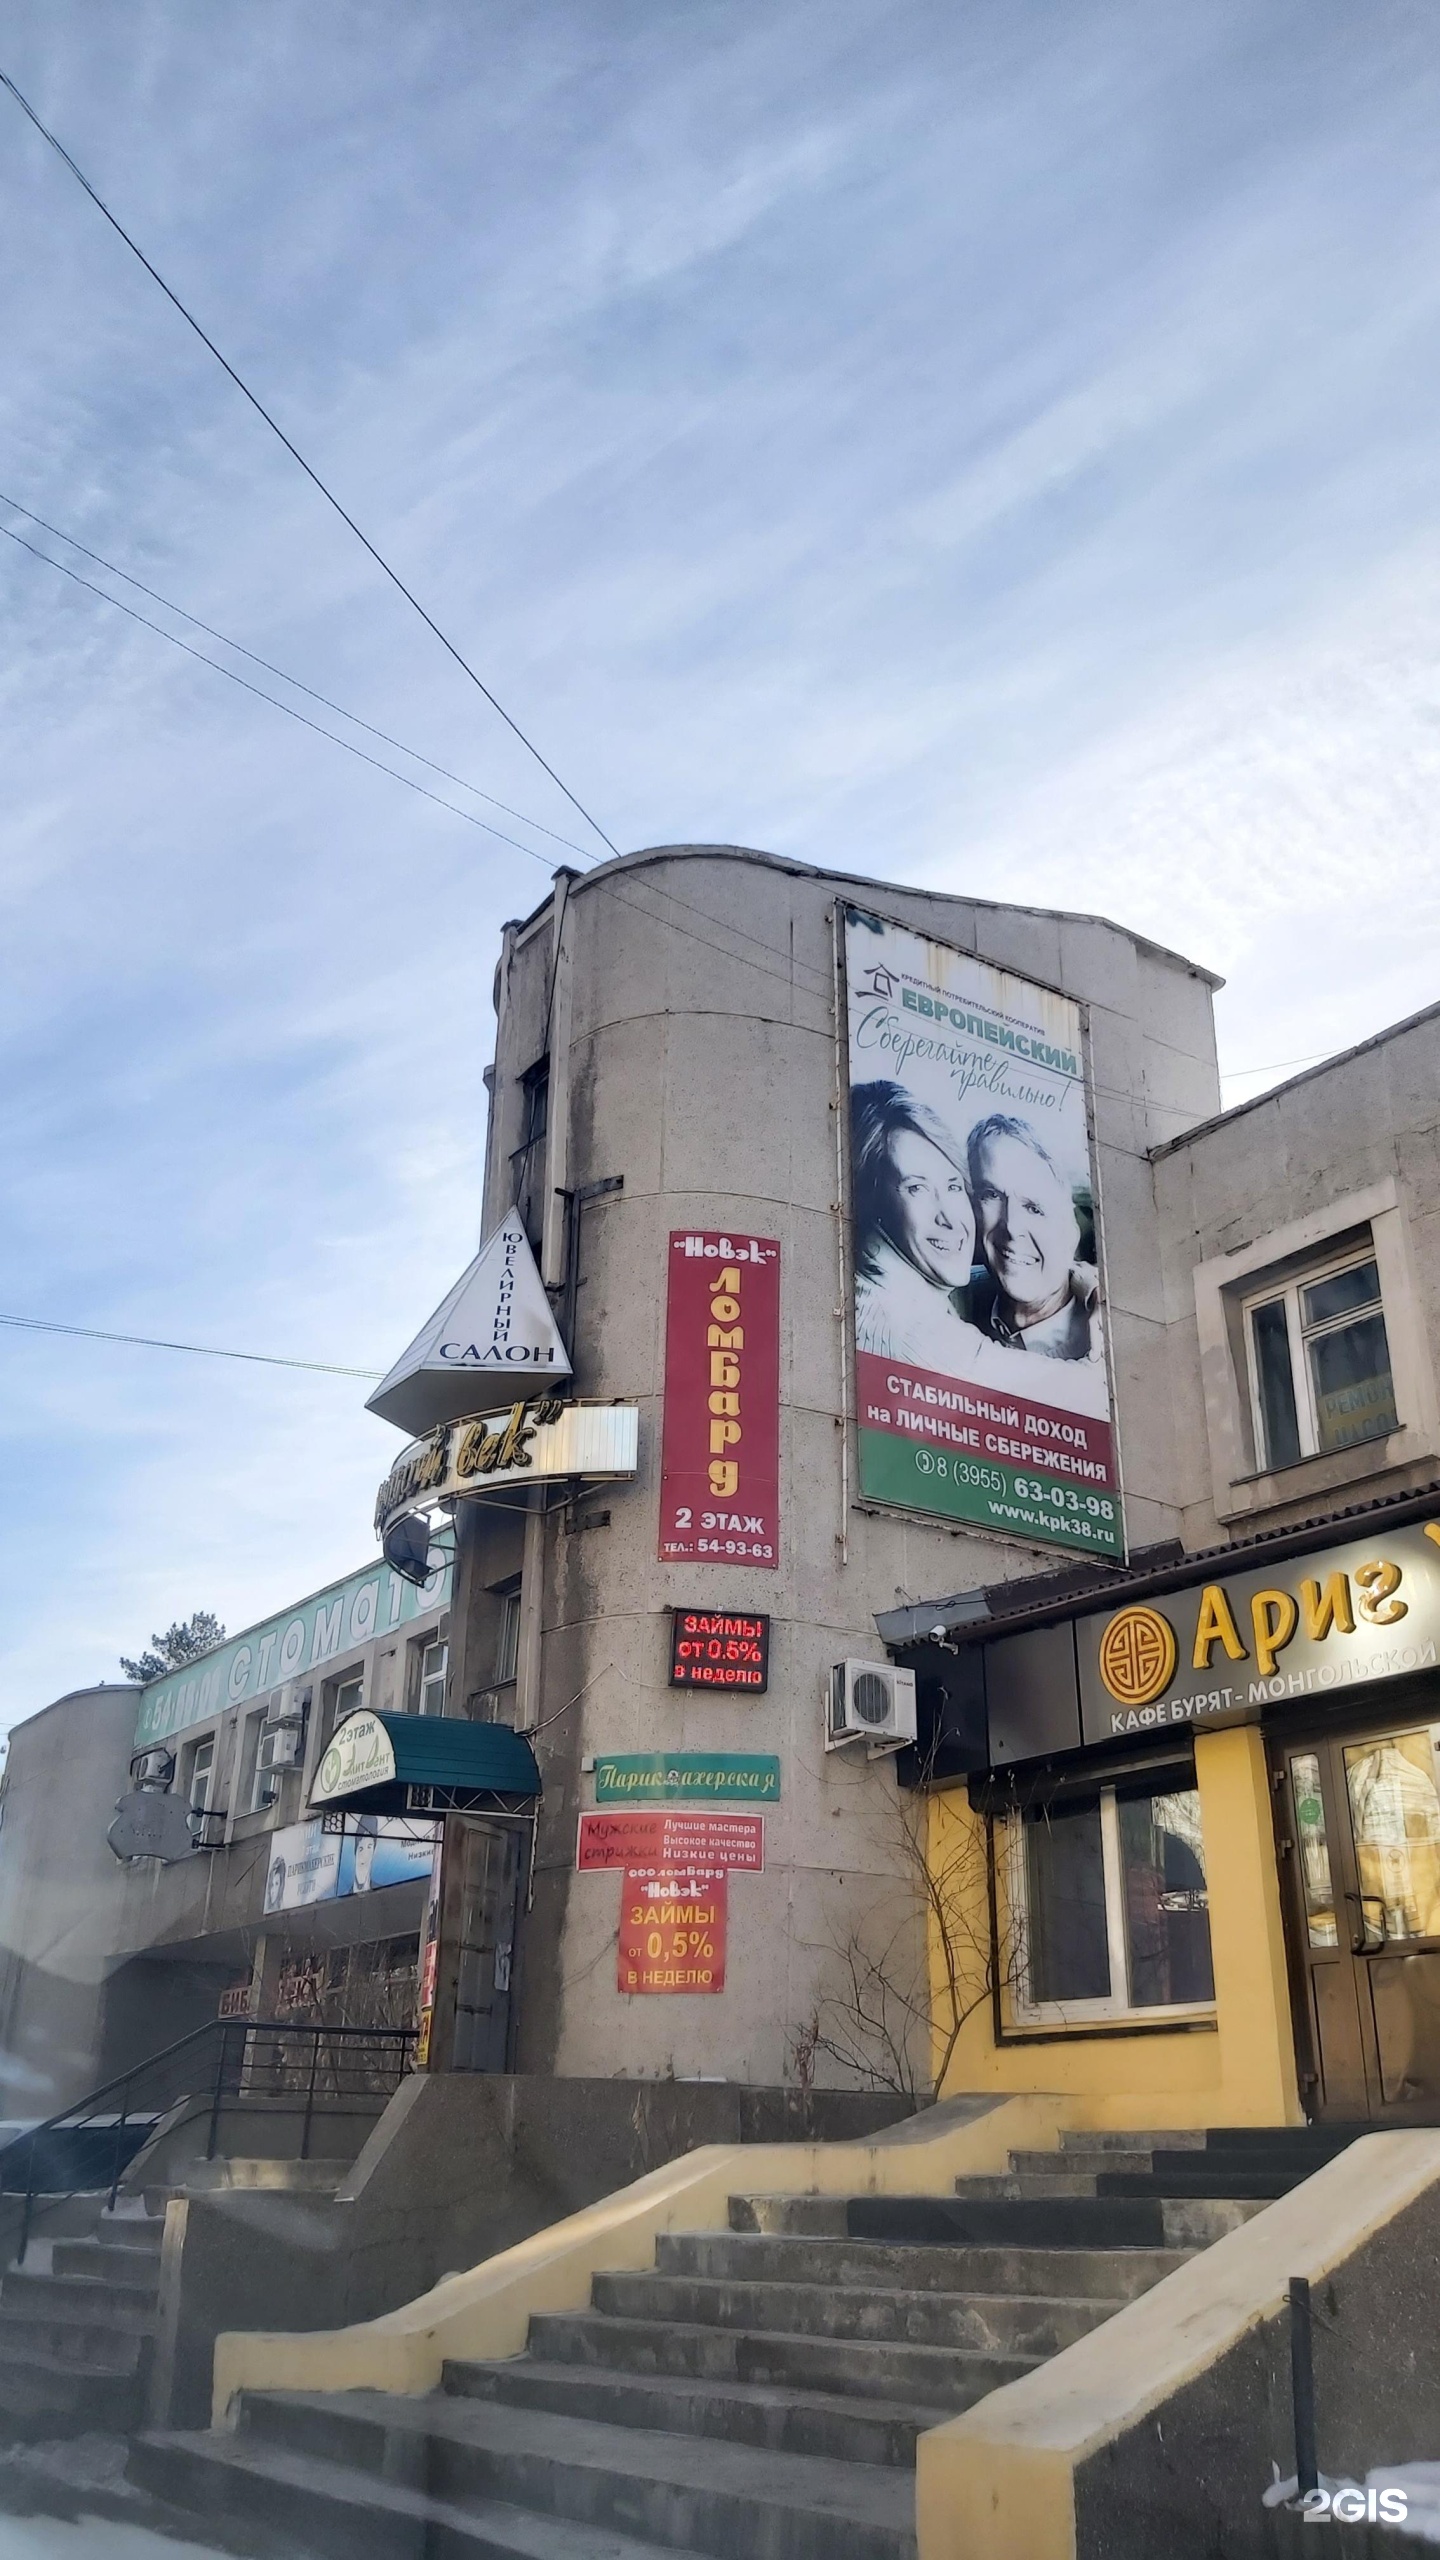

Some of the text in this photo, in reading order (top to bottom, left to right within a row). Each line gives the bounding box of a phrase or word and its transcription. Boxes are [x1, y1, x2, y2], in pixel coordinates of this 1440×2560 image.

[901, 973, 1046, 1036] КРЕДИТНЫЙ ПОТРЕБИТЕЛЬСКИЙ КООПЕРАТИВ
[856, 1006, 997, 1075] Сберегайте
[901, 987, 1077, 1075] ЕВРОПЕЙСКИЙ
[950, 1060, 1072, 1112] правильно!
[493, 1232, 523, 1342] ЮВЕЛИРНЫЙ
[438, 1343, 555, 1363] САЛОН
[886, 1375, 1087, 1450] СТАБИЛЬНЫЙ ДОХОД
[867, 1405, 1107, 1482] на ЛИЧНЫЕ СБЕРЕЖЕНИЯ
[936, 1457, 1114, 1520] 8 (3955) 63-03-98
[675, 1507, 765, 1535] 2 ЭТАЖ
[988, 1499, 1115, 1544] www.kpk38.ru
[697, 1538, 773, 1559] 54-93-63
[684, 1613, 763, 1637] ЗАЙМЫ
[707, 1638, 762, 1662] 0.5%
[674, 1664, 762, 1684] в неделю
[1111, 1705, 1166, 1733] КАФЕ
[587, 1821, 657, 1840] Мужские
[664, 1819, 757, 1835] Лучшие мастера
[584, 1846, 658, 1864] стрижки
[663, 1835, 756, 1849] Высокое качество
[663, 1848, 756, 1863] Низкие цены
[630, 1900, 715, 1925] ЗАЙМЫ
[647, 1930, 714, 1963] 0,5%
[627, 1969, 713, 1986] В НЕДЕЛЮ
